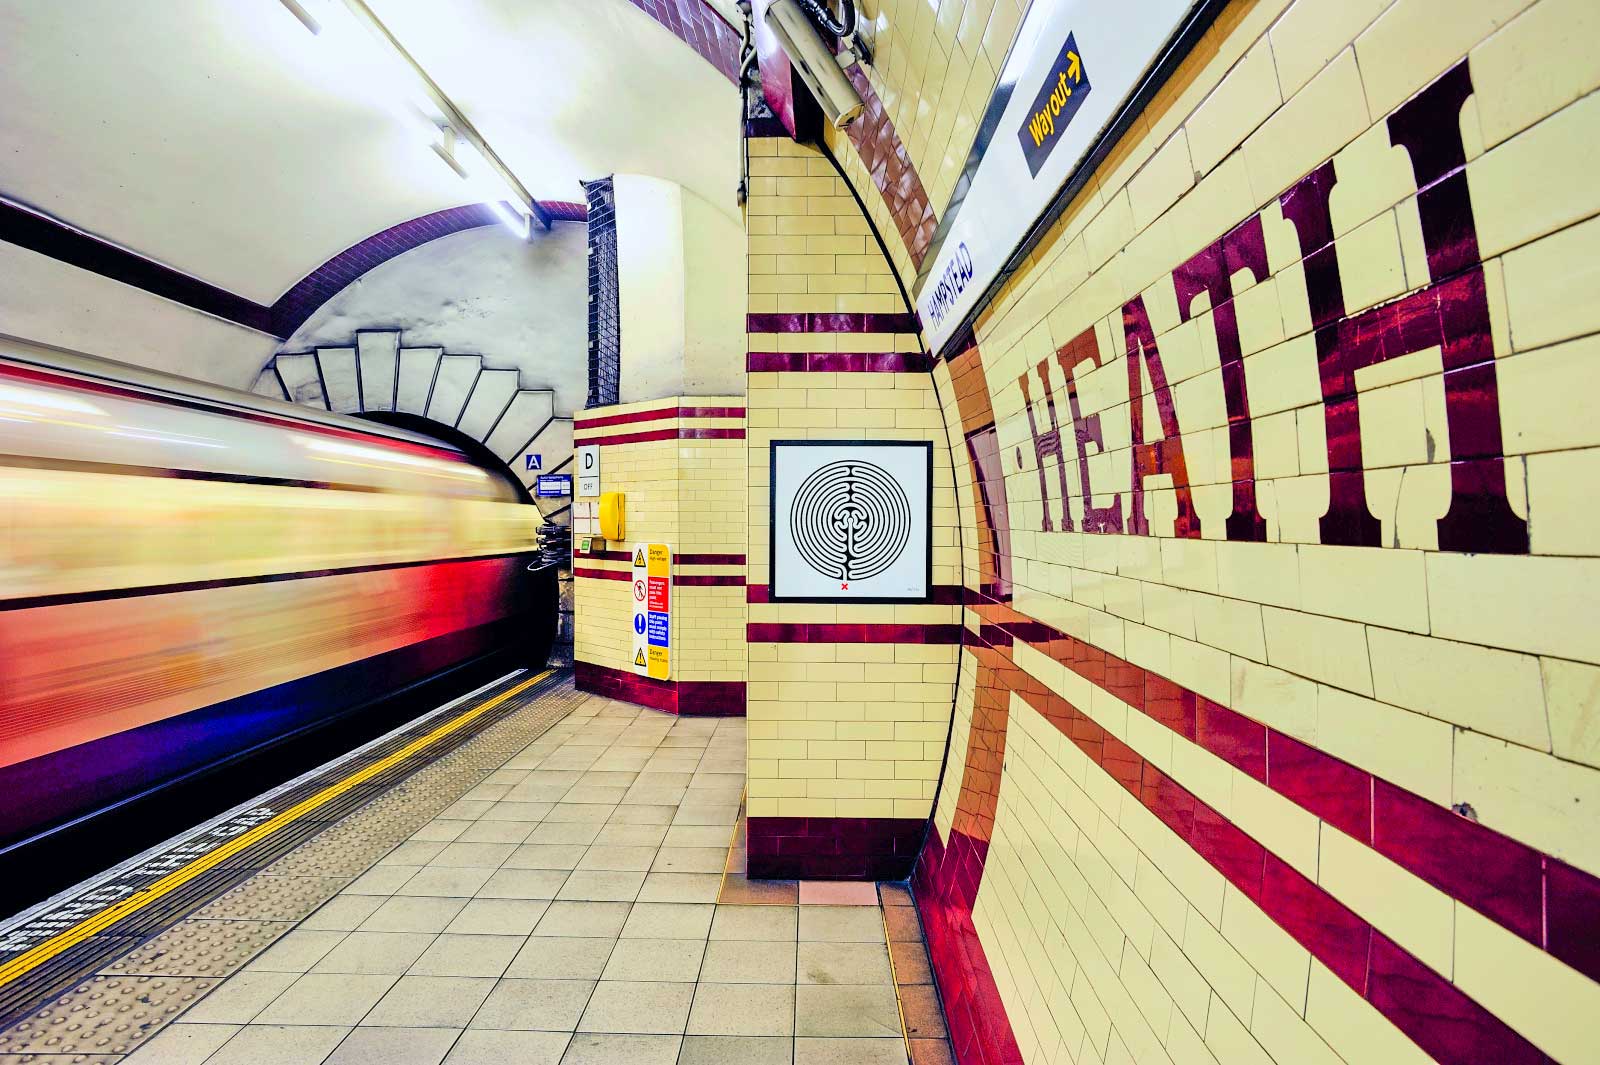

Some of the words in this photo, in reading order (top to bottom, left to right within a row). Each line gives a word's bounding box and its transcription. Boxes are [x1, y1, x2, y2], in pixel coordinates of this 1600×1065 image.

[1028, 103, 1055, 147] Way
[1050, 72, 1072, 117] out
[927, 241, 973, 332] HAMPSTEAD
[1018, 56, 1531, 555] HEATH
[528, 456, 540, 469] A
[586, 453, 593, 470] D
[649, 649, 663, 657] Danger
[0, 886, 134, 951] MIND
[121, 842, 222, 879] THE
[208, 807, 277, 837] GAP
